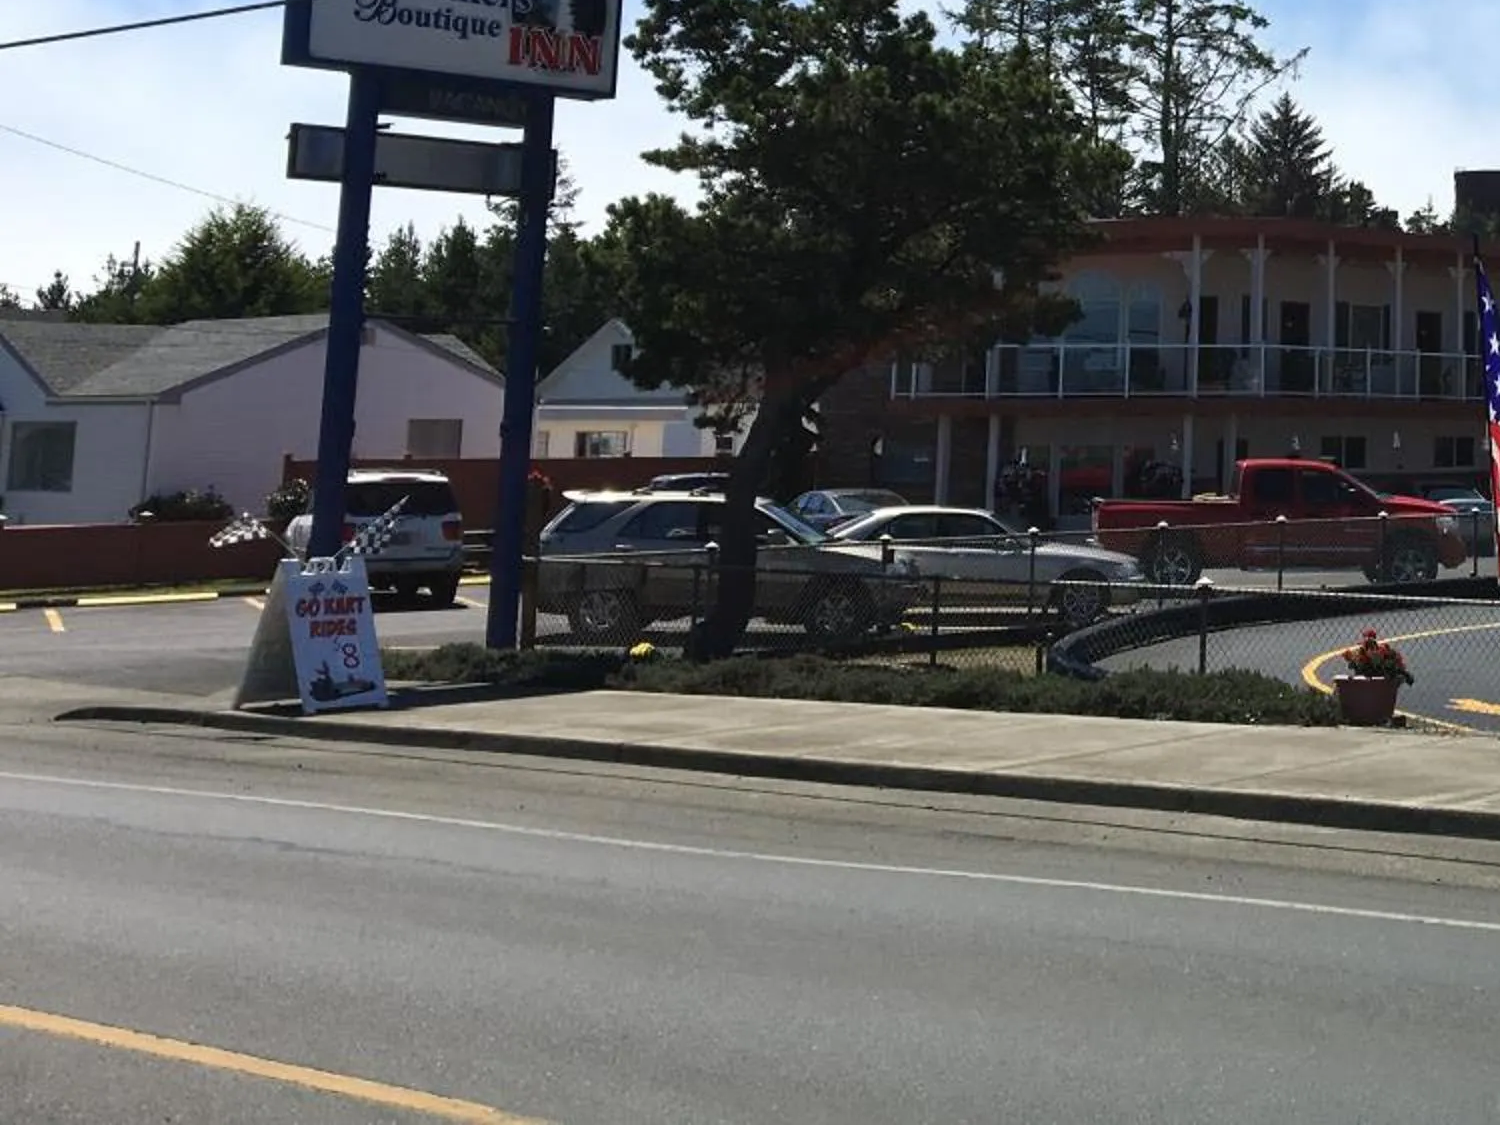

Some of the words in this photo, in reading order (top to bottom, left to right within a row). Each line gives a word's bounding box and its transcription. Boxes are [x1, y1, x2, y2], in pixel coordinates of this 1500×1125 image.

[507, 25, 602, 76] INN
[296, 597, 320, 618] GO
[323, 596, 366, 615] KART
[310, 618, 357, 639] RIDES
